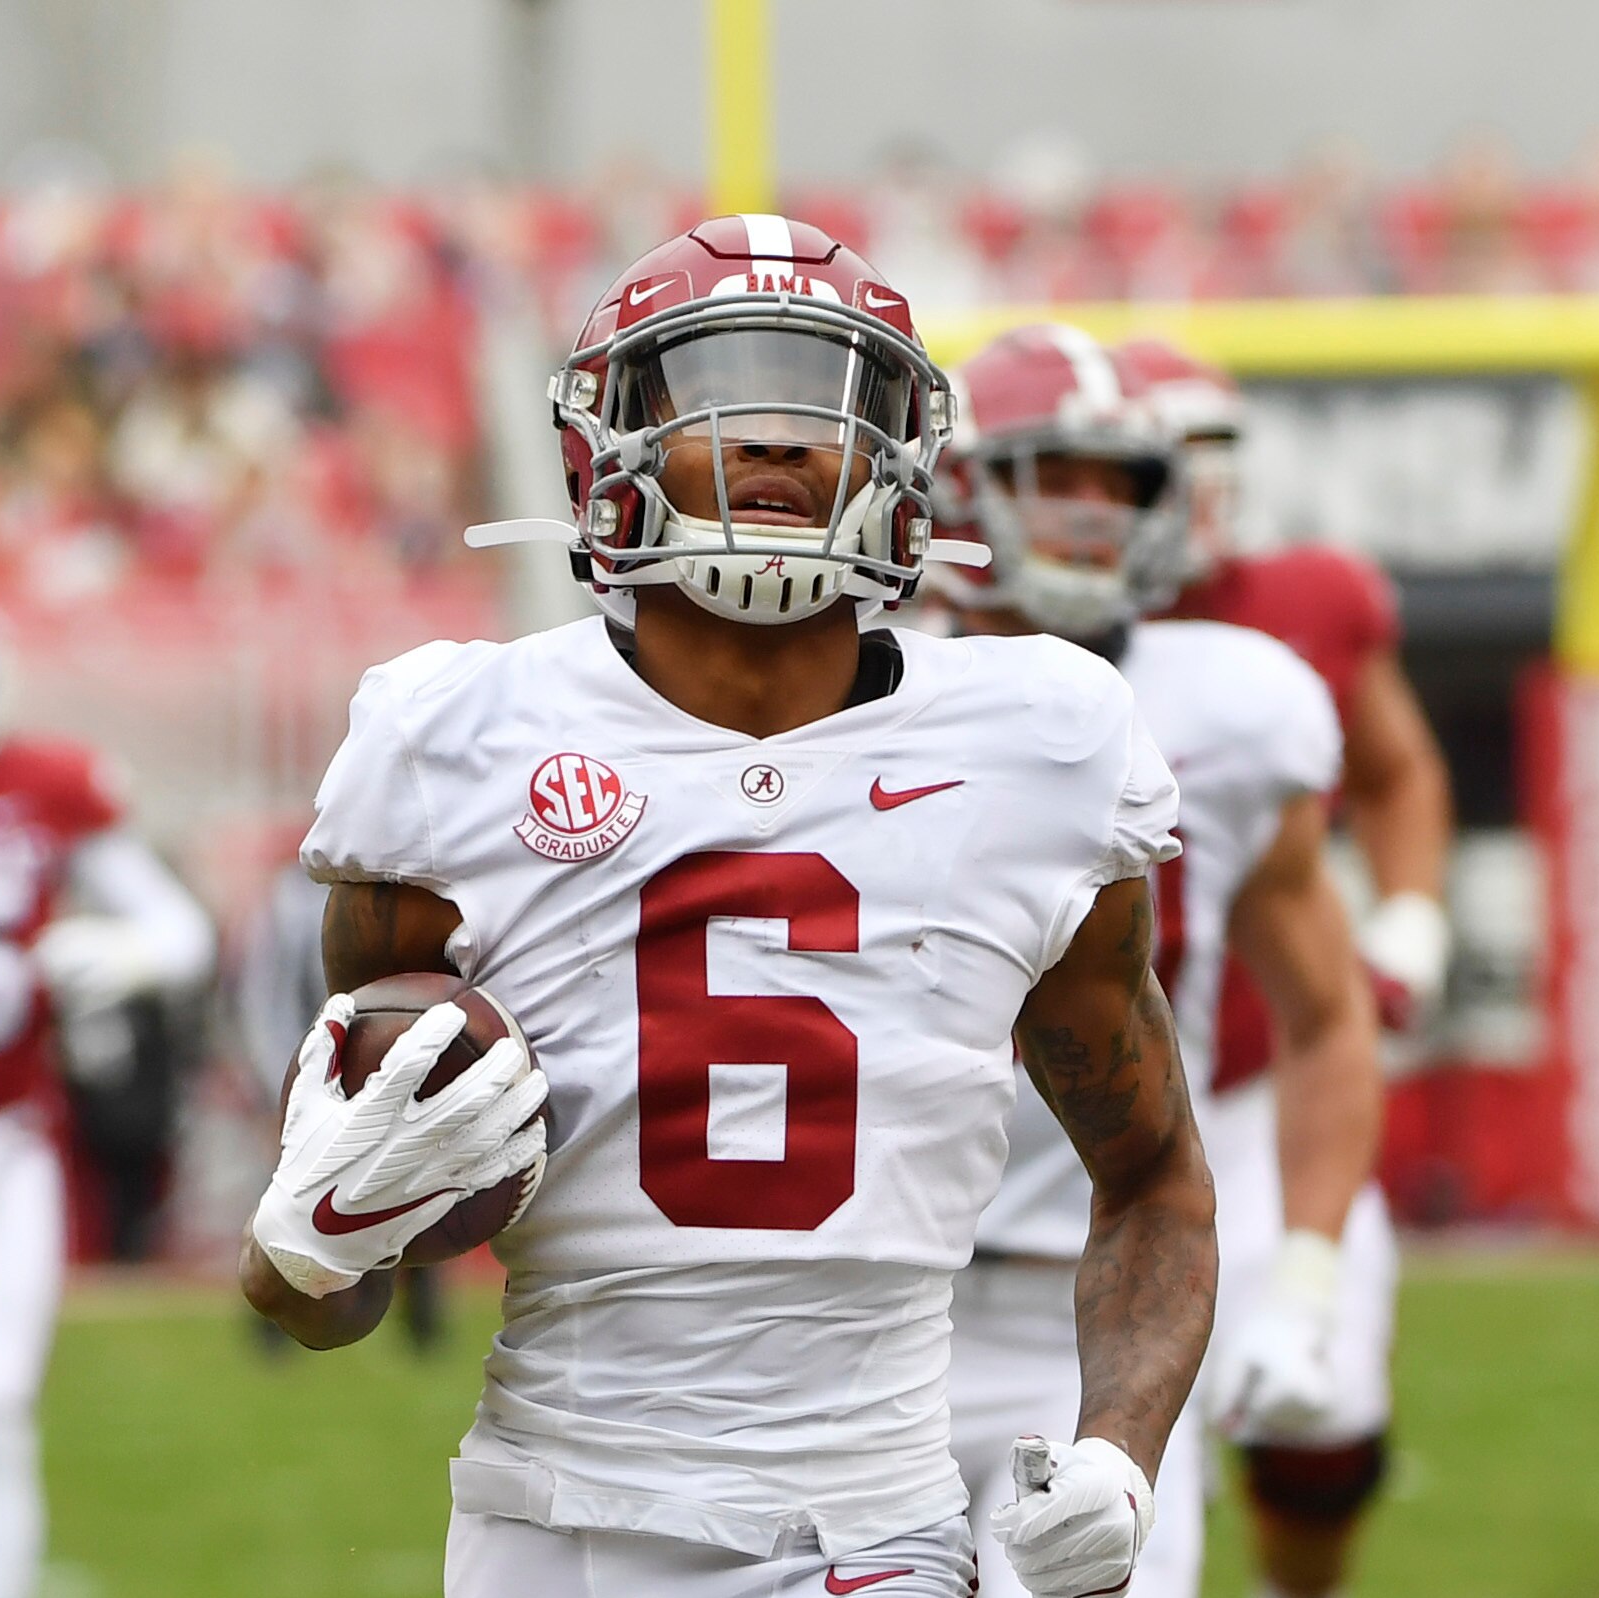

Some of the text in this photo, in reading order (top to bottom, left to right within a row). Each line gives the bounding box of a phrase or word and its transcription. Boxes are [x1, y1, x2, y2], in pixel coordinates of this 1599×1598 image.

[746, 273, 813, 296] BAMA
[534, 755, 617, 830] SEC
[534, 814, 633, 858] GRADUATE
[635, 851, 860, 1231] 6
